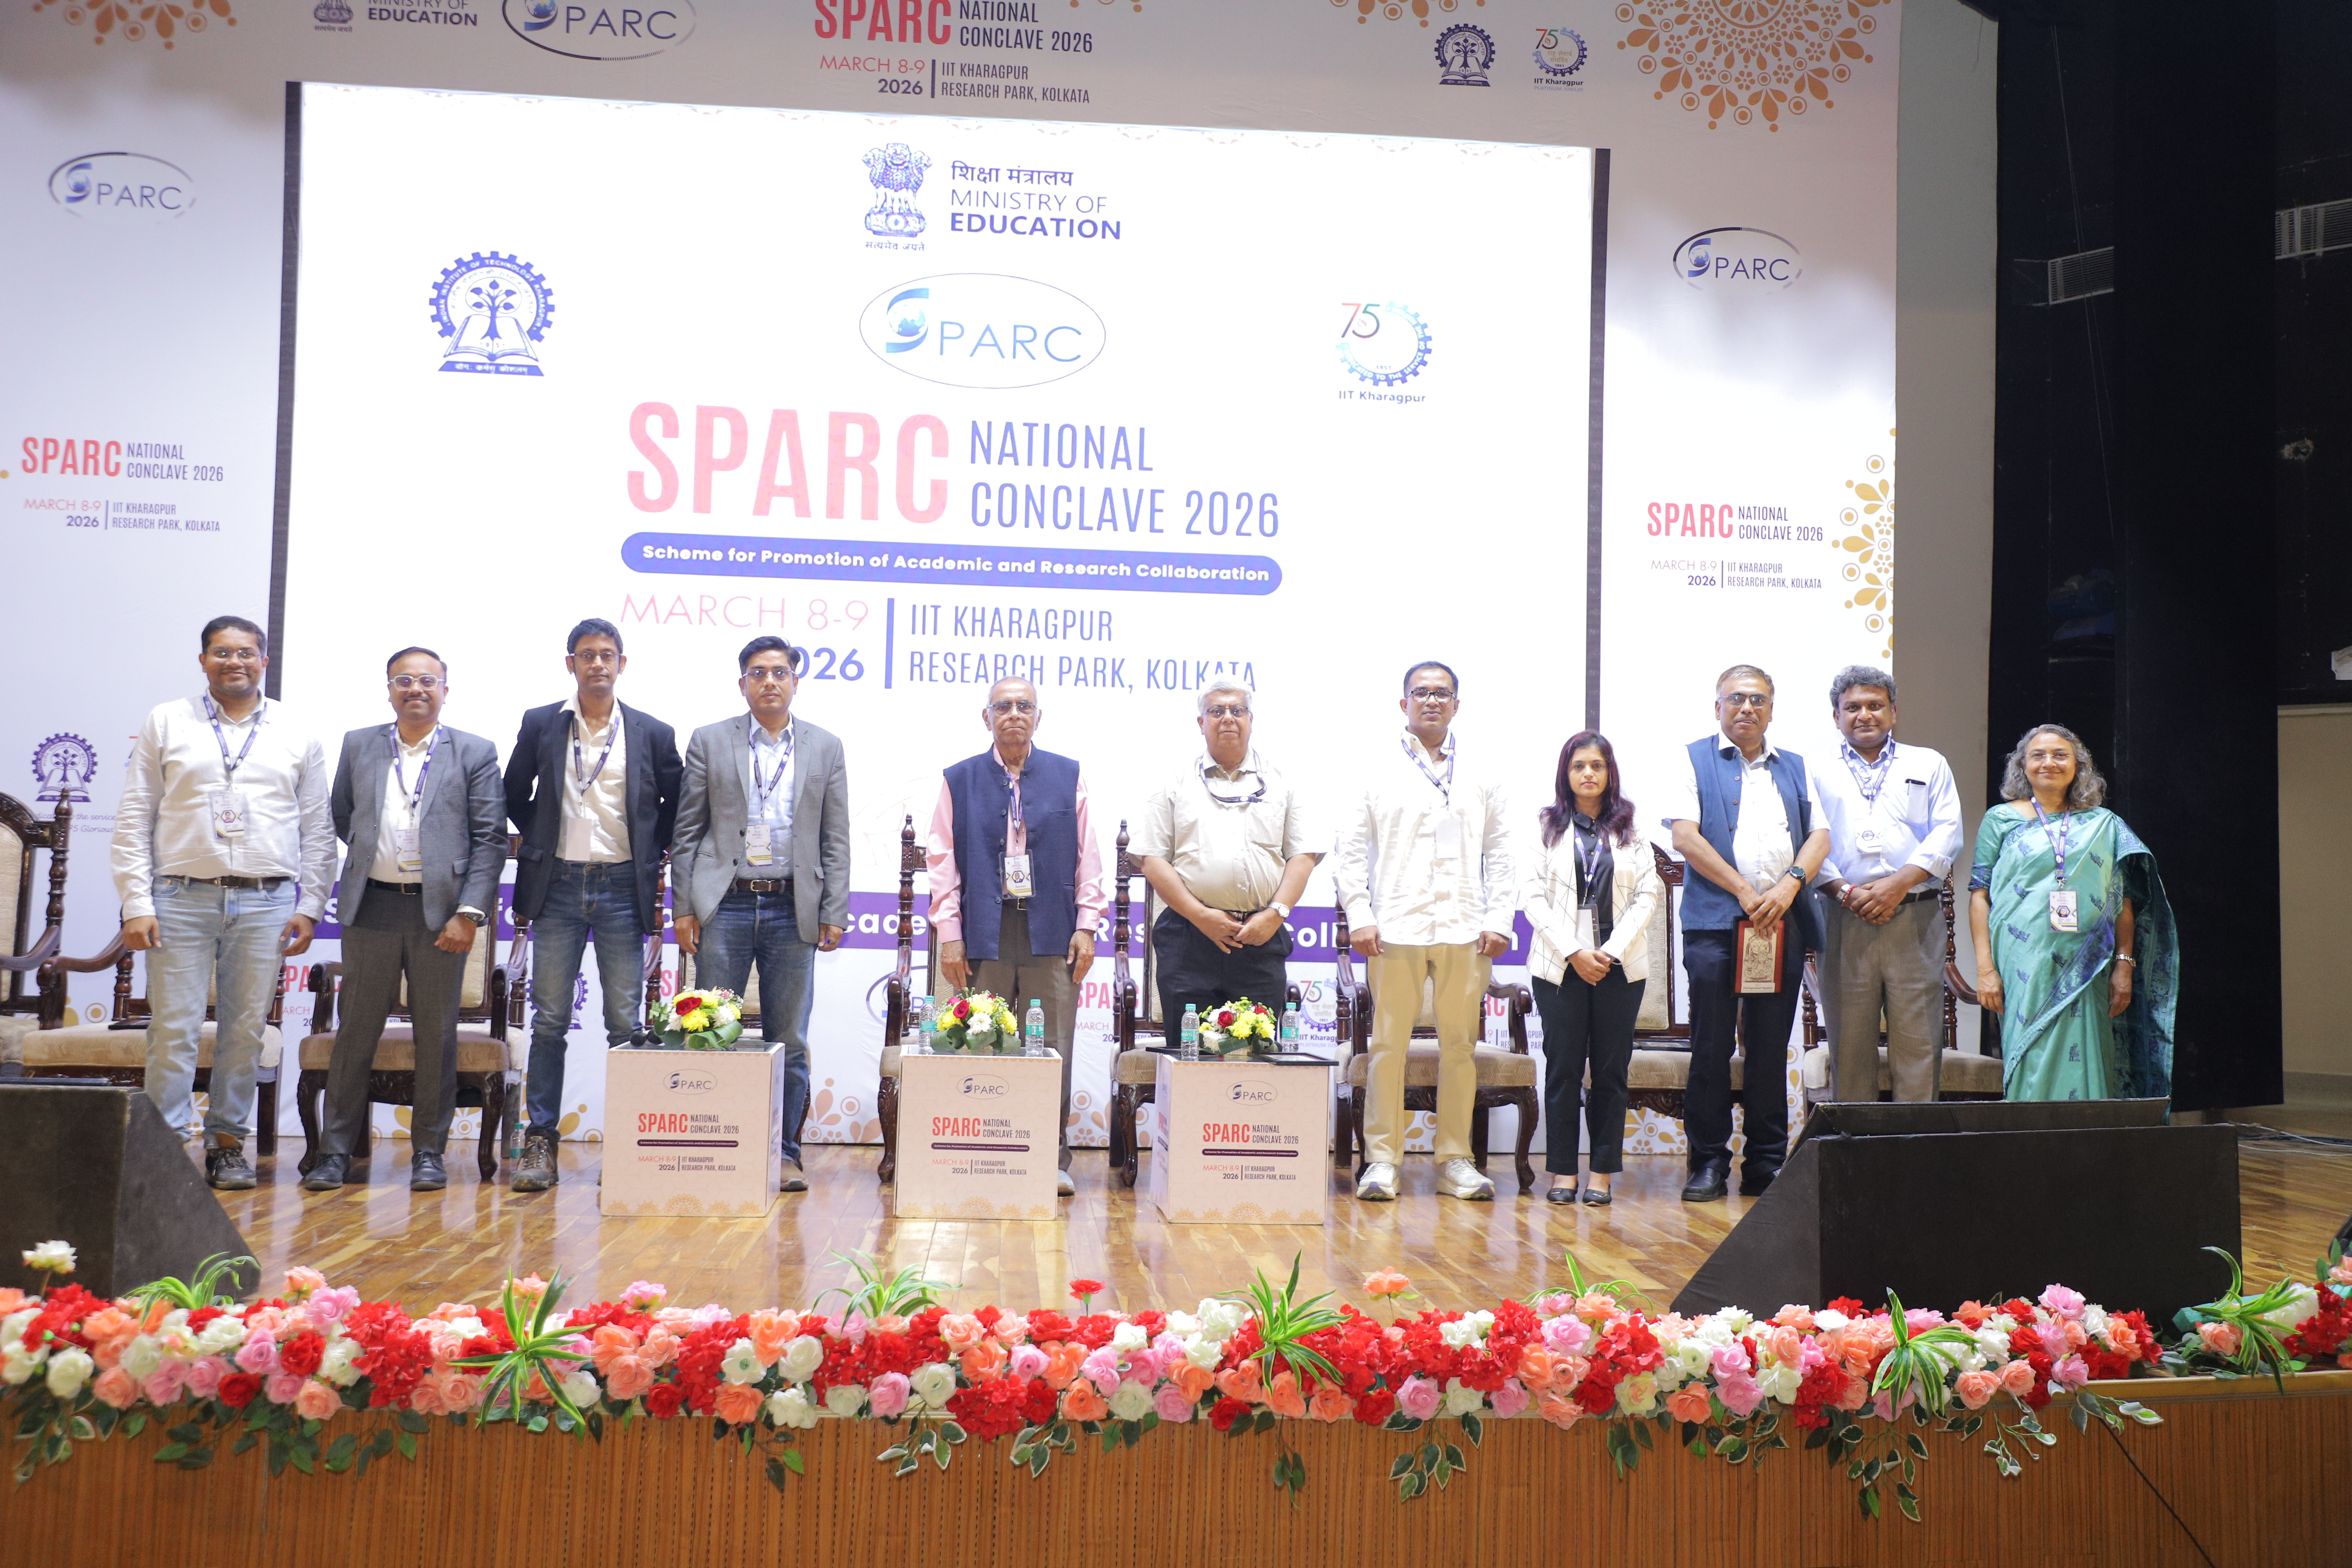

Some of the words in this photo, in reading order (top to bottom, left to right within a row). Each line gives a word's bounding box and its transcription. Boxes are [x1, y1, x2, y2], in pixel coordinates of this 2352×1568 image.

[448, 0, 467, 9] OF
[960, 0, 1038, 22] NATIONAL
[369, 8, 477, 26] EDUCATION
[815, 0, 951, 44] SPARC
[960, 26, 1043, 49] CONCLAVE
[1052, 31, 1092, 52] 2026
[1536, 29, 1558, 49] 75
[820, 55, 890, 72] MARCH
[899, 59, 925, 74] 8-9
[943, 62, 955, 76] IIT
[960, 63, 1028, 80] KHARAGPUR
[879, 79, 923, 95] 2026
[942, 82, 999, 98] RESEARCH
[1005, 85, 1037, 102] PARK,
[1043, 87, 1089, 103] KOLKATA
[951, 161, 1000, 183] शिक्षा
[1007, 166, 1073, 186] मंत्रालय
[65, 162, 182, 211] SPARC
[952, 189, 1066, 211] MINISTRY
[1076, 196, 1107, 213] OF
[951, 213, 1120, 239] EDUCATION
[1688, 238, 1790, 280] SPARC
[886, 288, 1081, 362] SPARC
[1341, 303, 1380, 339] 75
[1360, 392, 1426, 404] Kharagpur
[127, 443, 184, 459] NATIONAL
[971, 421, 1153, 471] NATIONAL
[22, 437, 121, 476] SPARC
[628, 402, 949, 524] SPARC
[127, 463, 187, 479] CONCLAVE
[194, 466, 223, 481] 2026
[24, 499, 75, 510] MARCH
[81, 500, 101, 511] 8-9
[113, 502, 123, 512] IIT
[126, 503, 176, 514] KHARAGPUR
[972, 482, 1164, 533] CONCLAVE
[1186, 490, 1278, 537] 2026
[1739, 506, 1788, 521] NATIONAL
[67, 515, 99, 527] 2026
[113, 517, 155, 528] RESEARCH
[158, 519, 182, 531] PARK,
[185, 520, 219, 531] KOLKATA
[1648, 502, 1733, 538] SPARC
[1740, 525, 1791, 540] CONCLAVE
[1797, 527, 1822, 541] 2026
[643, 546, 723, 561] Scheme
[728, 548, 756, 562] for
[761, 550, 864, 566] Promotion
[870, 554, 888, 567] of
[894, 556, 992, 571] Academic
[998, 560, 1035, 573] and
[1041, 561, 1130, 576] Research
[1136, 563, 1270, 582] Collaboration
[1651, 560, 1695, 570] MARCH
[1700, 561, 1717, 571] 8-9
[1740, 563, 1782, 573] KHARAGPUR
[1688, 575, 1716, 586] 2026
[1728, 576, 1764, 586] RESEARCH
[1768, 577, 1788, 588] PARK,
[1792, 578, 1821, 588] KOLKATA
[620, 594, 785, 628] MARCH
[807, 599, 868, 630] 8-9
[912, 605, 941, 635] IIT
[955, 606, 1112, 641] KHARAGPUR
[792, 646, 864, 681] 026
[1059, 657, 1132, 693] PARK,
[1301, 980, 1322, 1003] 75
[670, 1073, 712, 1090] SPARC
[963, 1078, 1004, 1095] SPARC
[1233, 1084, 1272, 1101] SPARC
[639, 1113, 688, 1133] SPARC
[691, 1125, 721, 1133] CONCLAVE
[724, 1125, 739, 1134] 2026
[933, 1116, 980, 1137] SPARC
[1203, 1123, 1250, 1142] SPARC
[1253, 1125, 1279, 1133] NATIONAL
[983, 1129, 1012, 1138] CONCLAVE
[1015, 1130, 1030, 1138] 2026
[1284, 1136, 1298, 1144] 2026
